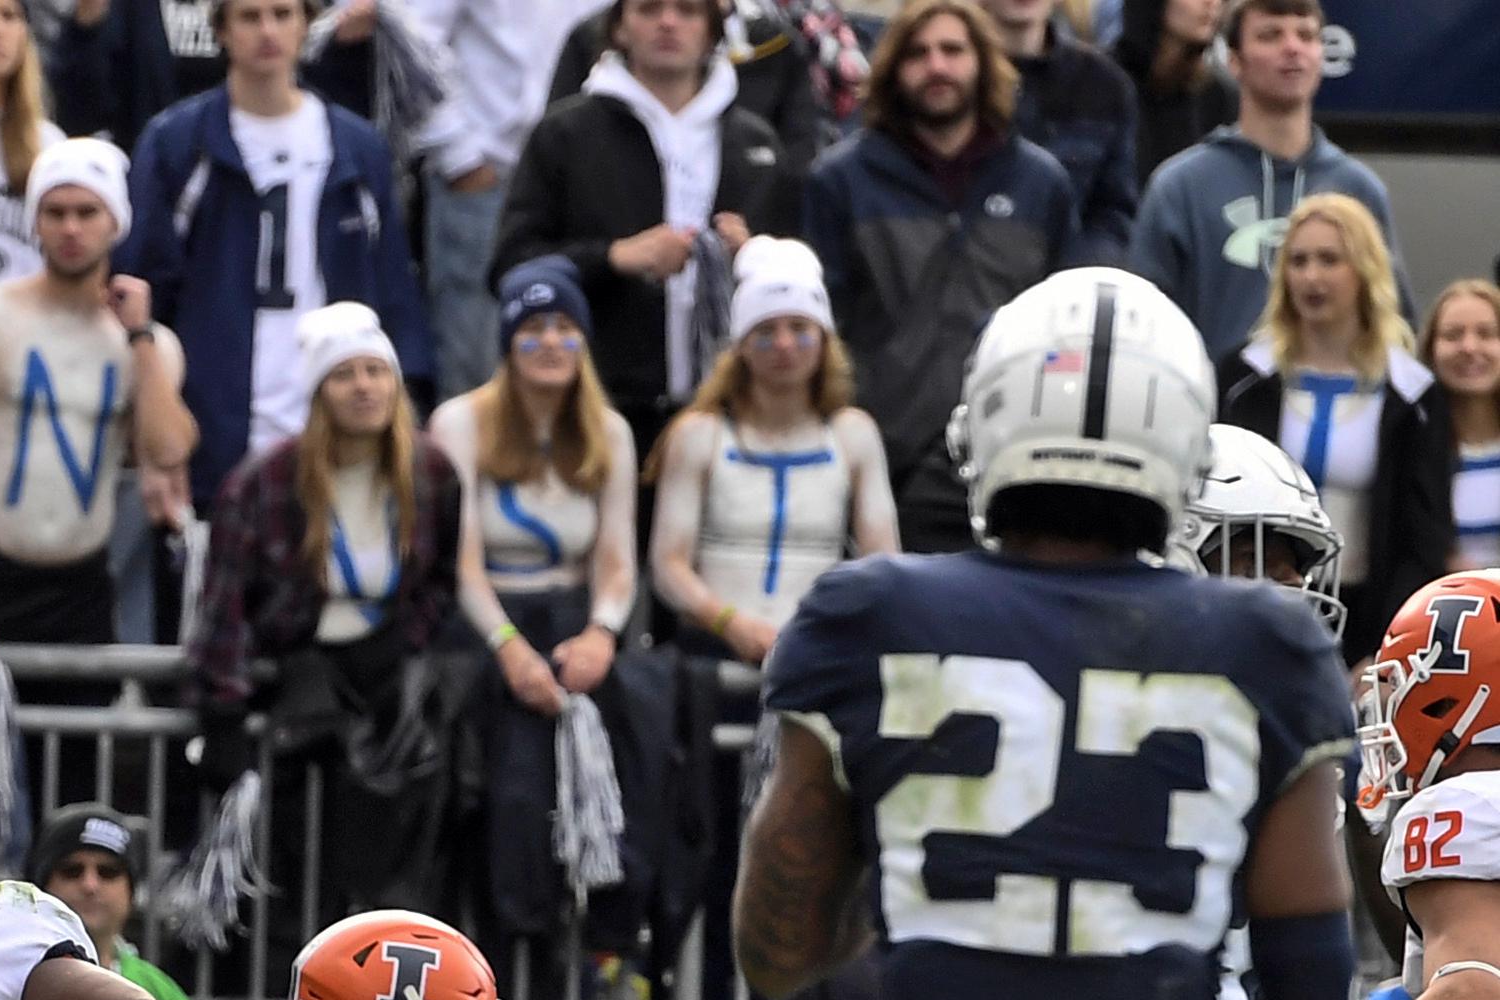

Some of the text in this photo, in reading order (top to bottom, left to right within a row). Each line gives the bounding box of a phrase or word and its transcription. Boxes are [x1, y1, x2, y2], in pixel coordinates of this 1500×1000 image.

[4, 347, 118, 516] N
[725, 448, 833, 596] T
[876, 653, 1260, 957] 23
[1402, 810, 1464, 874] 82
